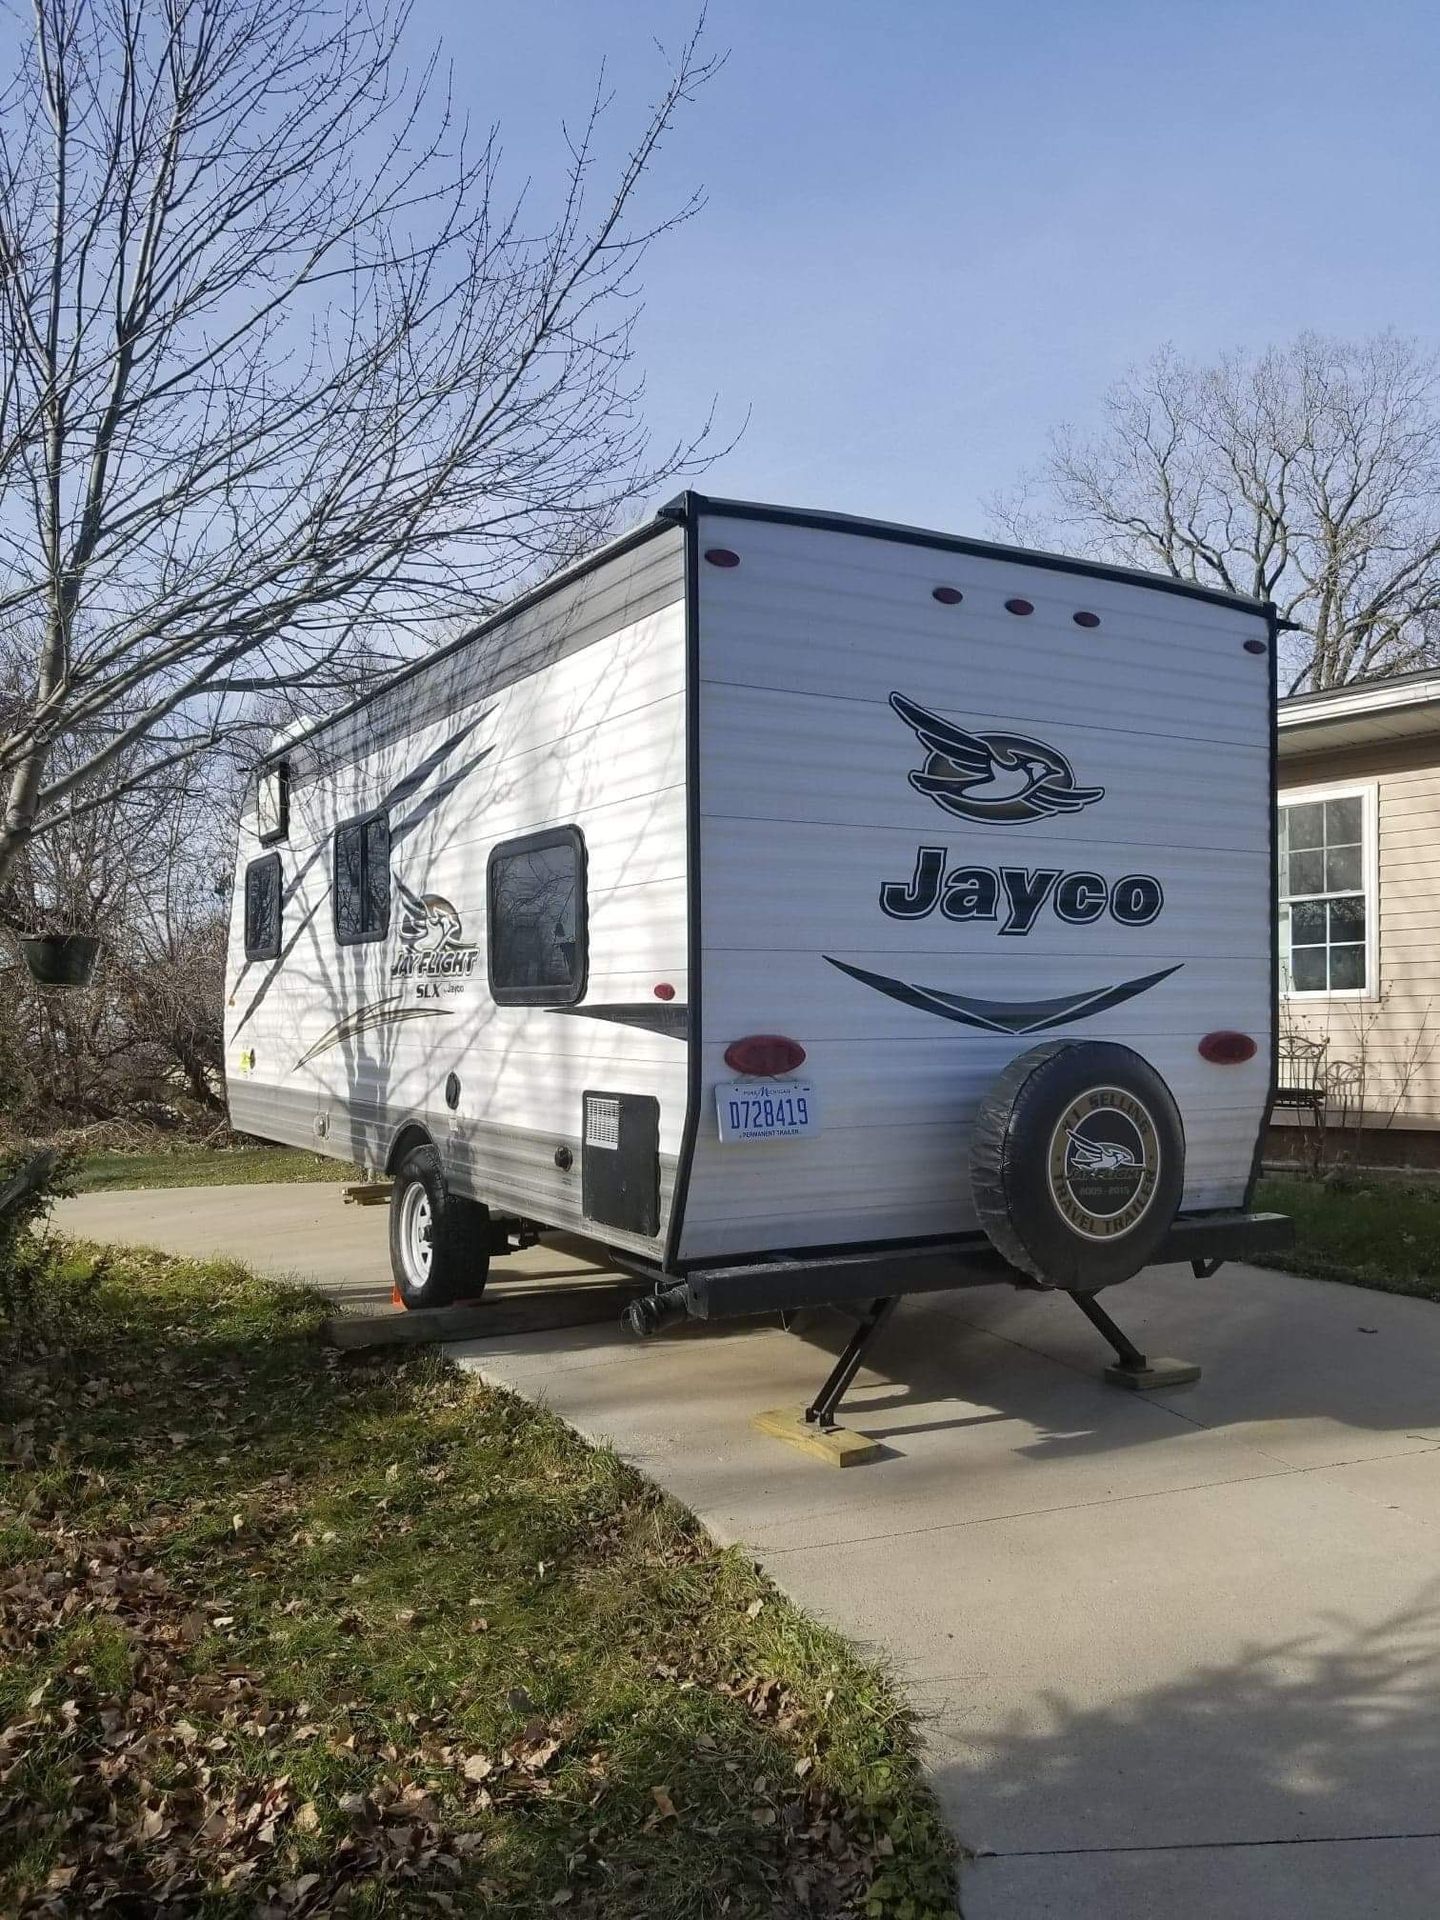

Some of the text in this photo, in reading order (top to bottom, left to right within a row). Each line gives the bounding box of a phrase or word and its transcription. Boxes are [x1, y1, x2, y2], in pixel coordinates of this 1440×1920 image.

[879, 846, 1164, 936] Jayco
[391, 949, 479, 980] JAY FLIGHT
[416, 983, 442, 998] SLX
[729, 1098, 809, 1130] D728419
[1088, 1092, 1150, 1135] SELLING
[742, 1128, 799, 1139] PERMANENT TRAILER
[1053, 1169, 1156, 1234] TRAVEL TRAILER
